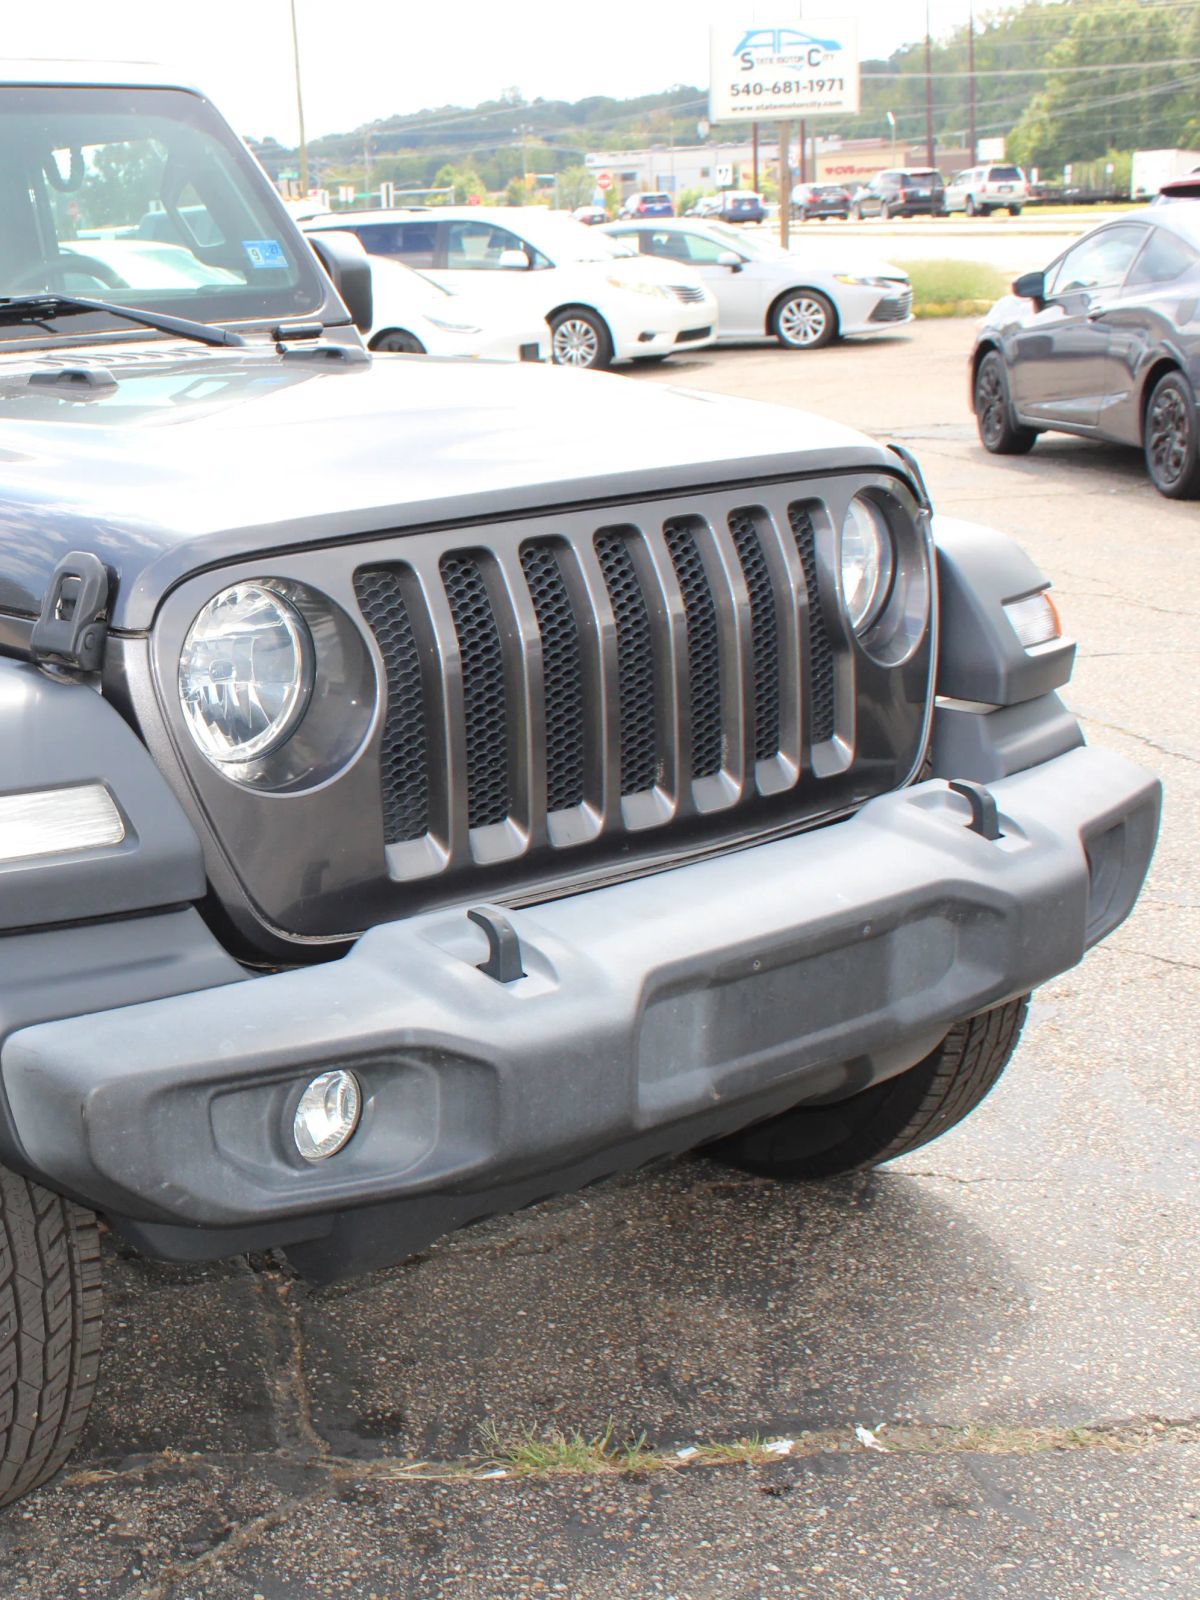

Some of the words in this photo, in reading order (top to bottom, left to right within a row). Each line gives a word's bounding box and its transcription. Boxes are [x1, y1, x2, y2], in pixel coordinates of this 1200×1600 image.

[741, 52, 774, 71] STATE
[776, 55, 804, 65] MOTOR
[807, 48, 834, 67] CITY
[730, 78, 844, 97] 540-681-1971
[731, 100, 843, 113] www.statemotorcity.com
